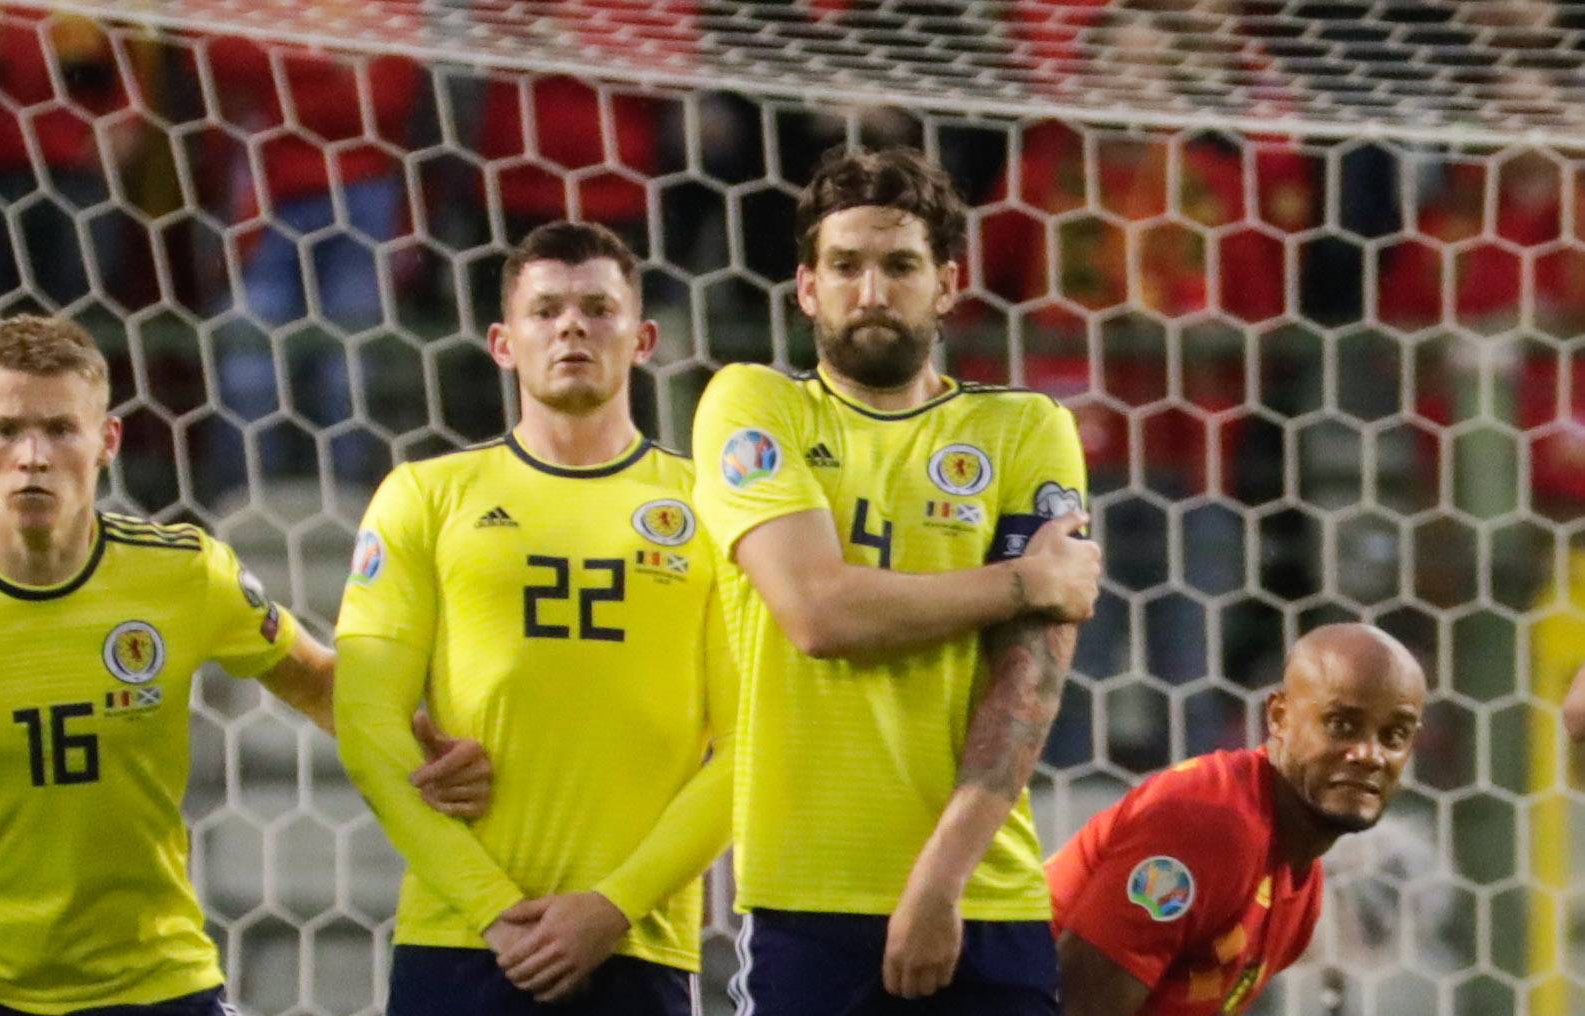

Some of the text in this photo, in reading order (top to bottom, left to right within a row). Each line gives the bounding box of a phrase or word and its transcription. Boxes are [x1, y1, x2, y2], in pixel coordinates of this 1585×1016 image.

[850, 497, 892, 569] 4
[523, 554, 625, 642] 22
[12, 702, 100, 787] 16
